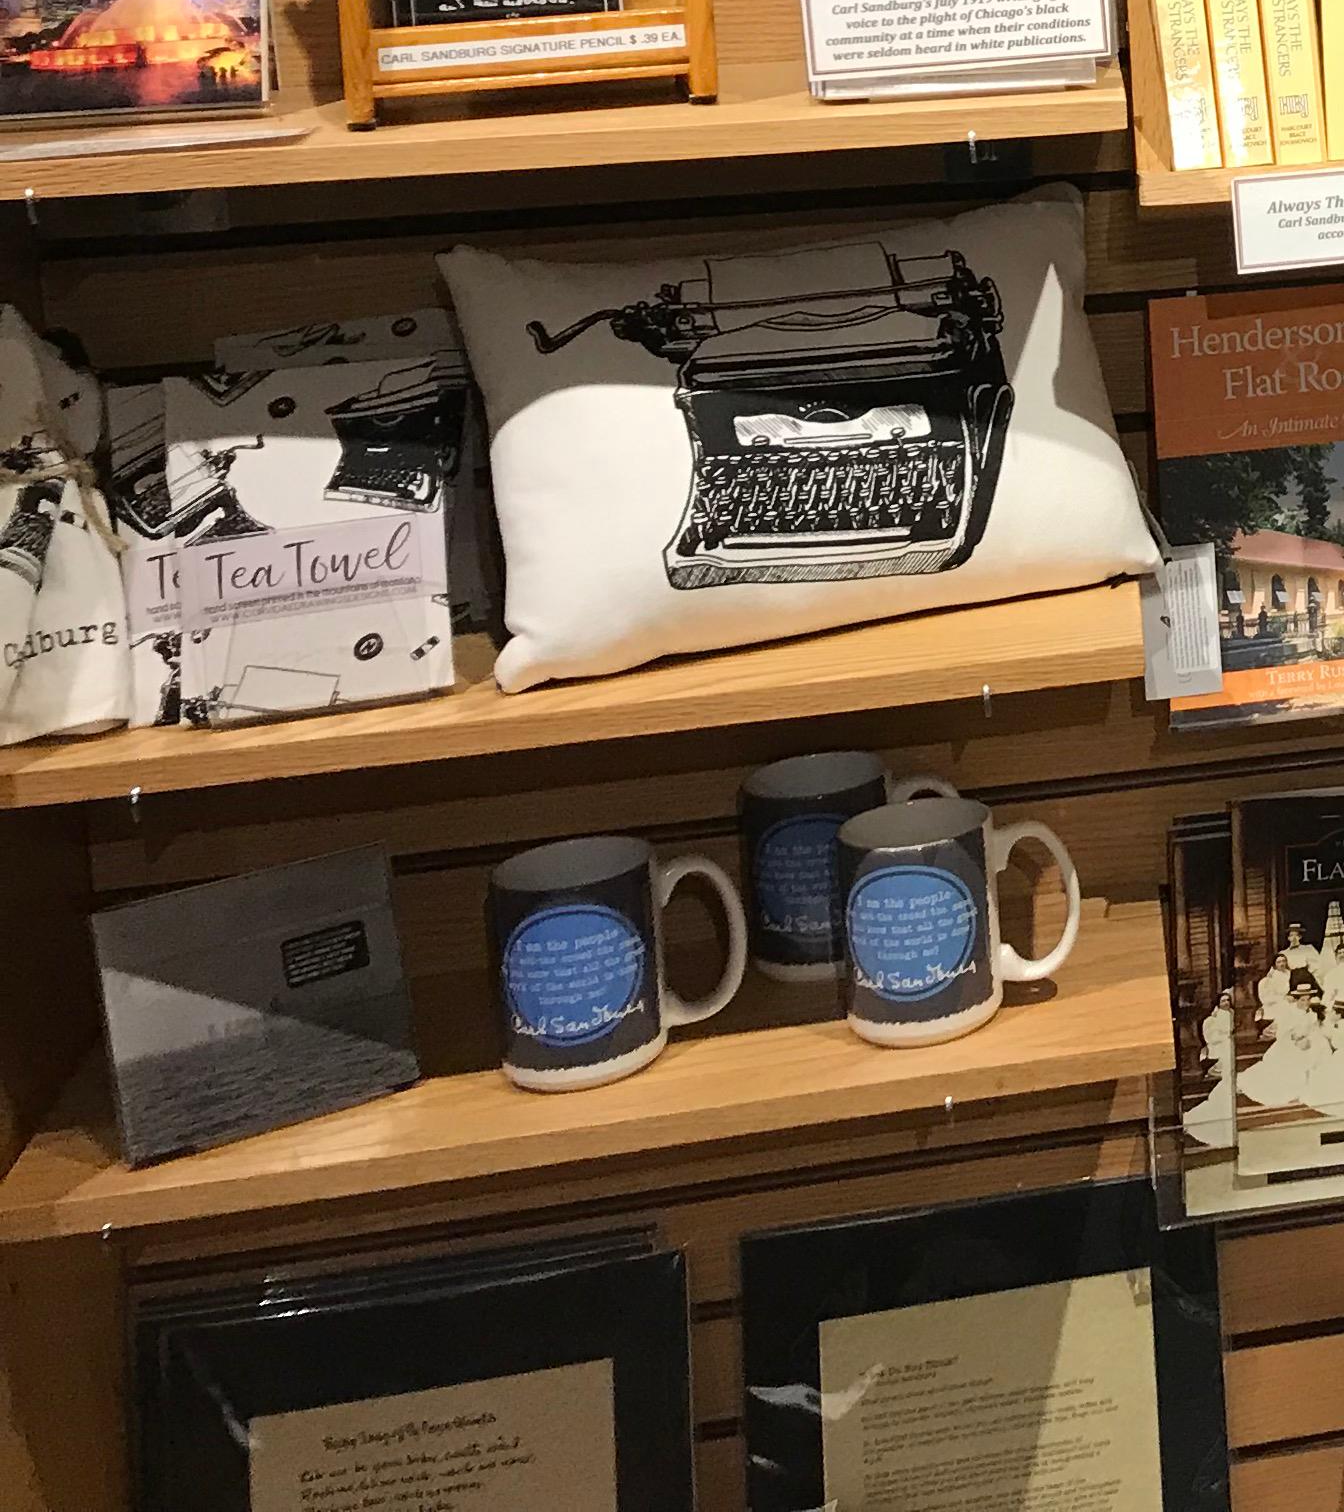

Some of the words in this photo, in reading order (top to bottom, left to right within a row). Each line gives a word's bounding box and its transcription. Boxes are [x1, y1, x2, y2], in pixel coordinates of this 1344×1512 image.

[381, 51, 417, 66] CARL
[421, 45, 496, 64] SANDBURG
[500, 41, 576, 56] SIGNATURE
[579, 37, 625, 51] PENCIL
[1267, 199, 1321, 215] Always
[1223, 361, 1289, 401] Flat
[205, 553, 283, 601] Tea
[283, 522, 413, 589] Towel
